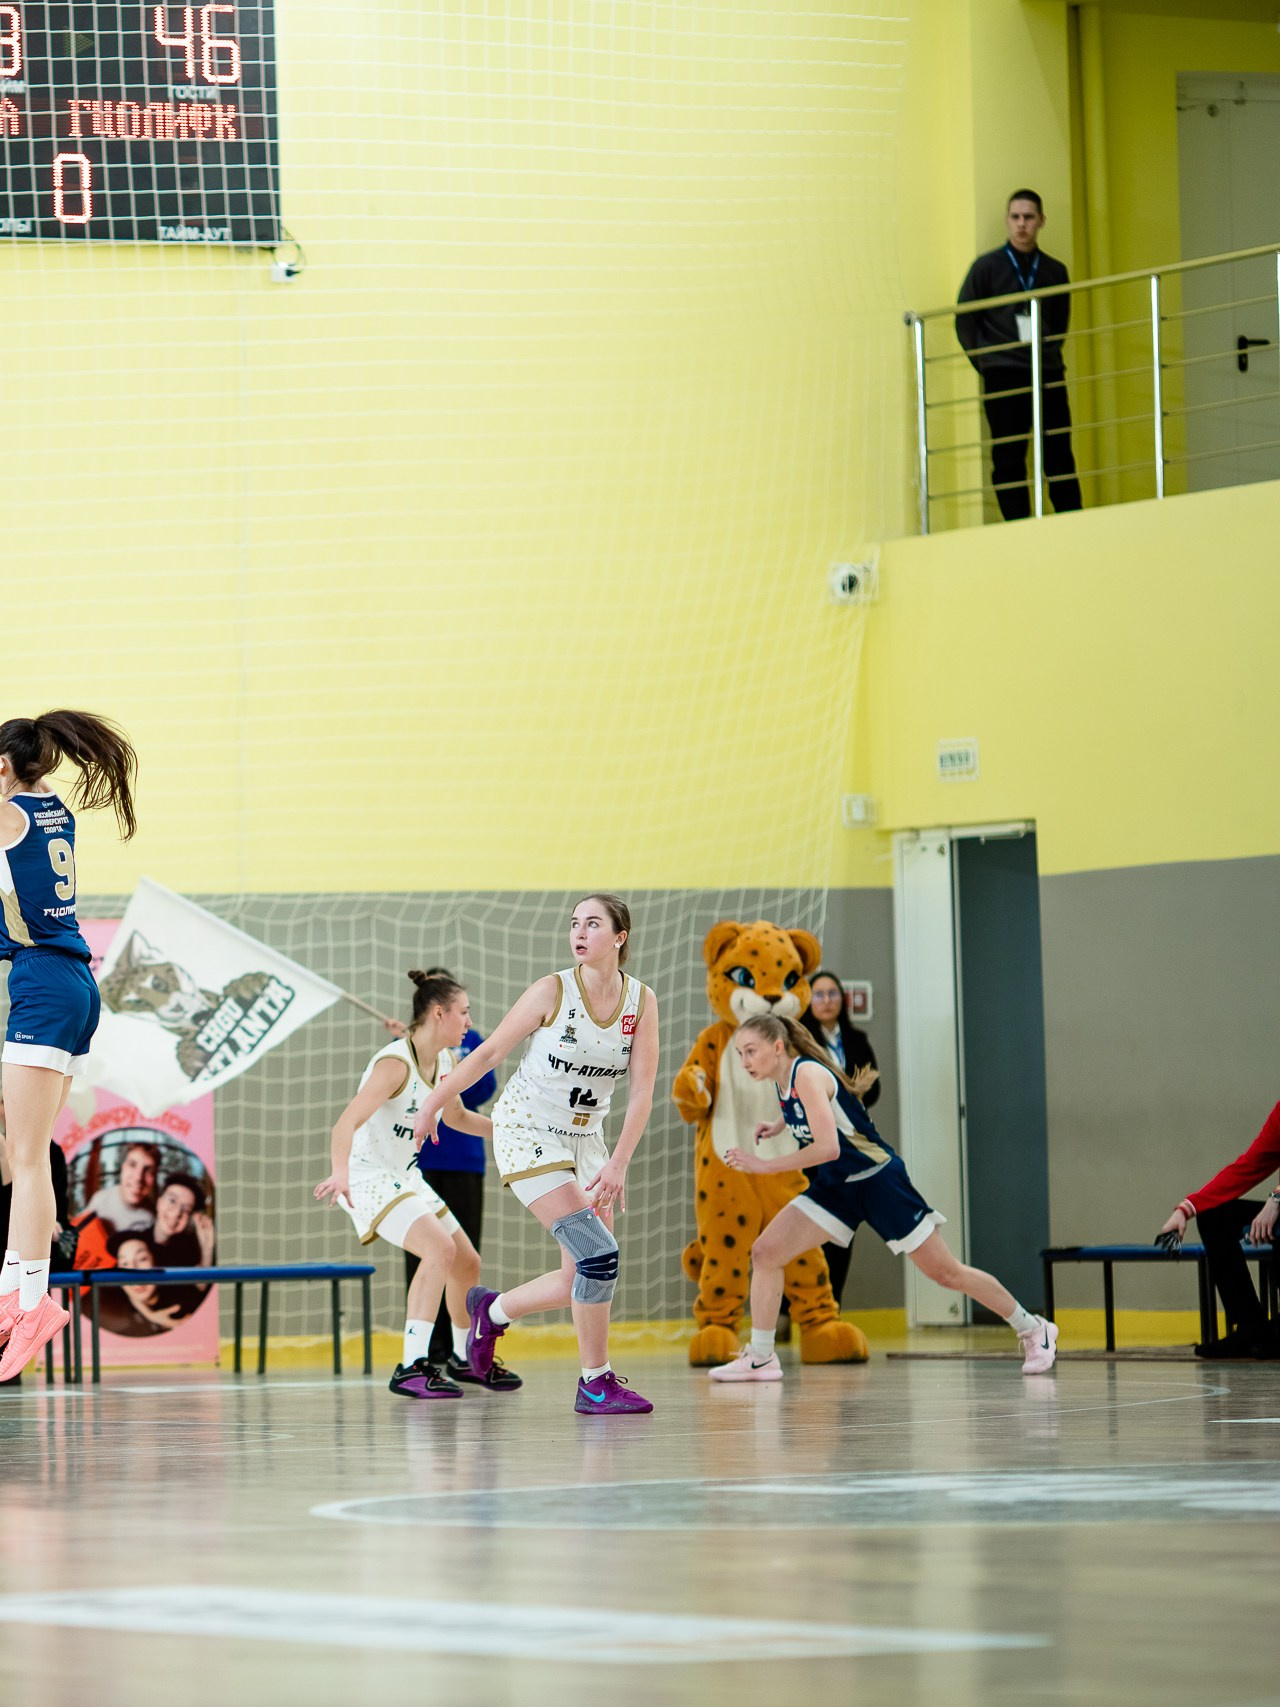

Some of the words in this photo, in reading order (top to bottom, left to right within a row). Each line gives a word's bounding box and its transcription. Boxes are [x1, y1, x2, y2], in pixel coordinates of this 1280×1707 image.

[154, 4, 241, 83] 46
[52, 153, 93, 224] 0
[47, 837, 75, 901] 9
[43, 903, 77, 919] ГЦОЛИ
